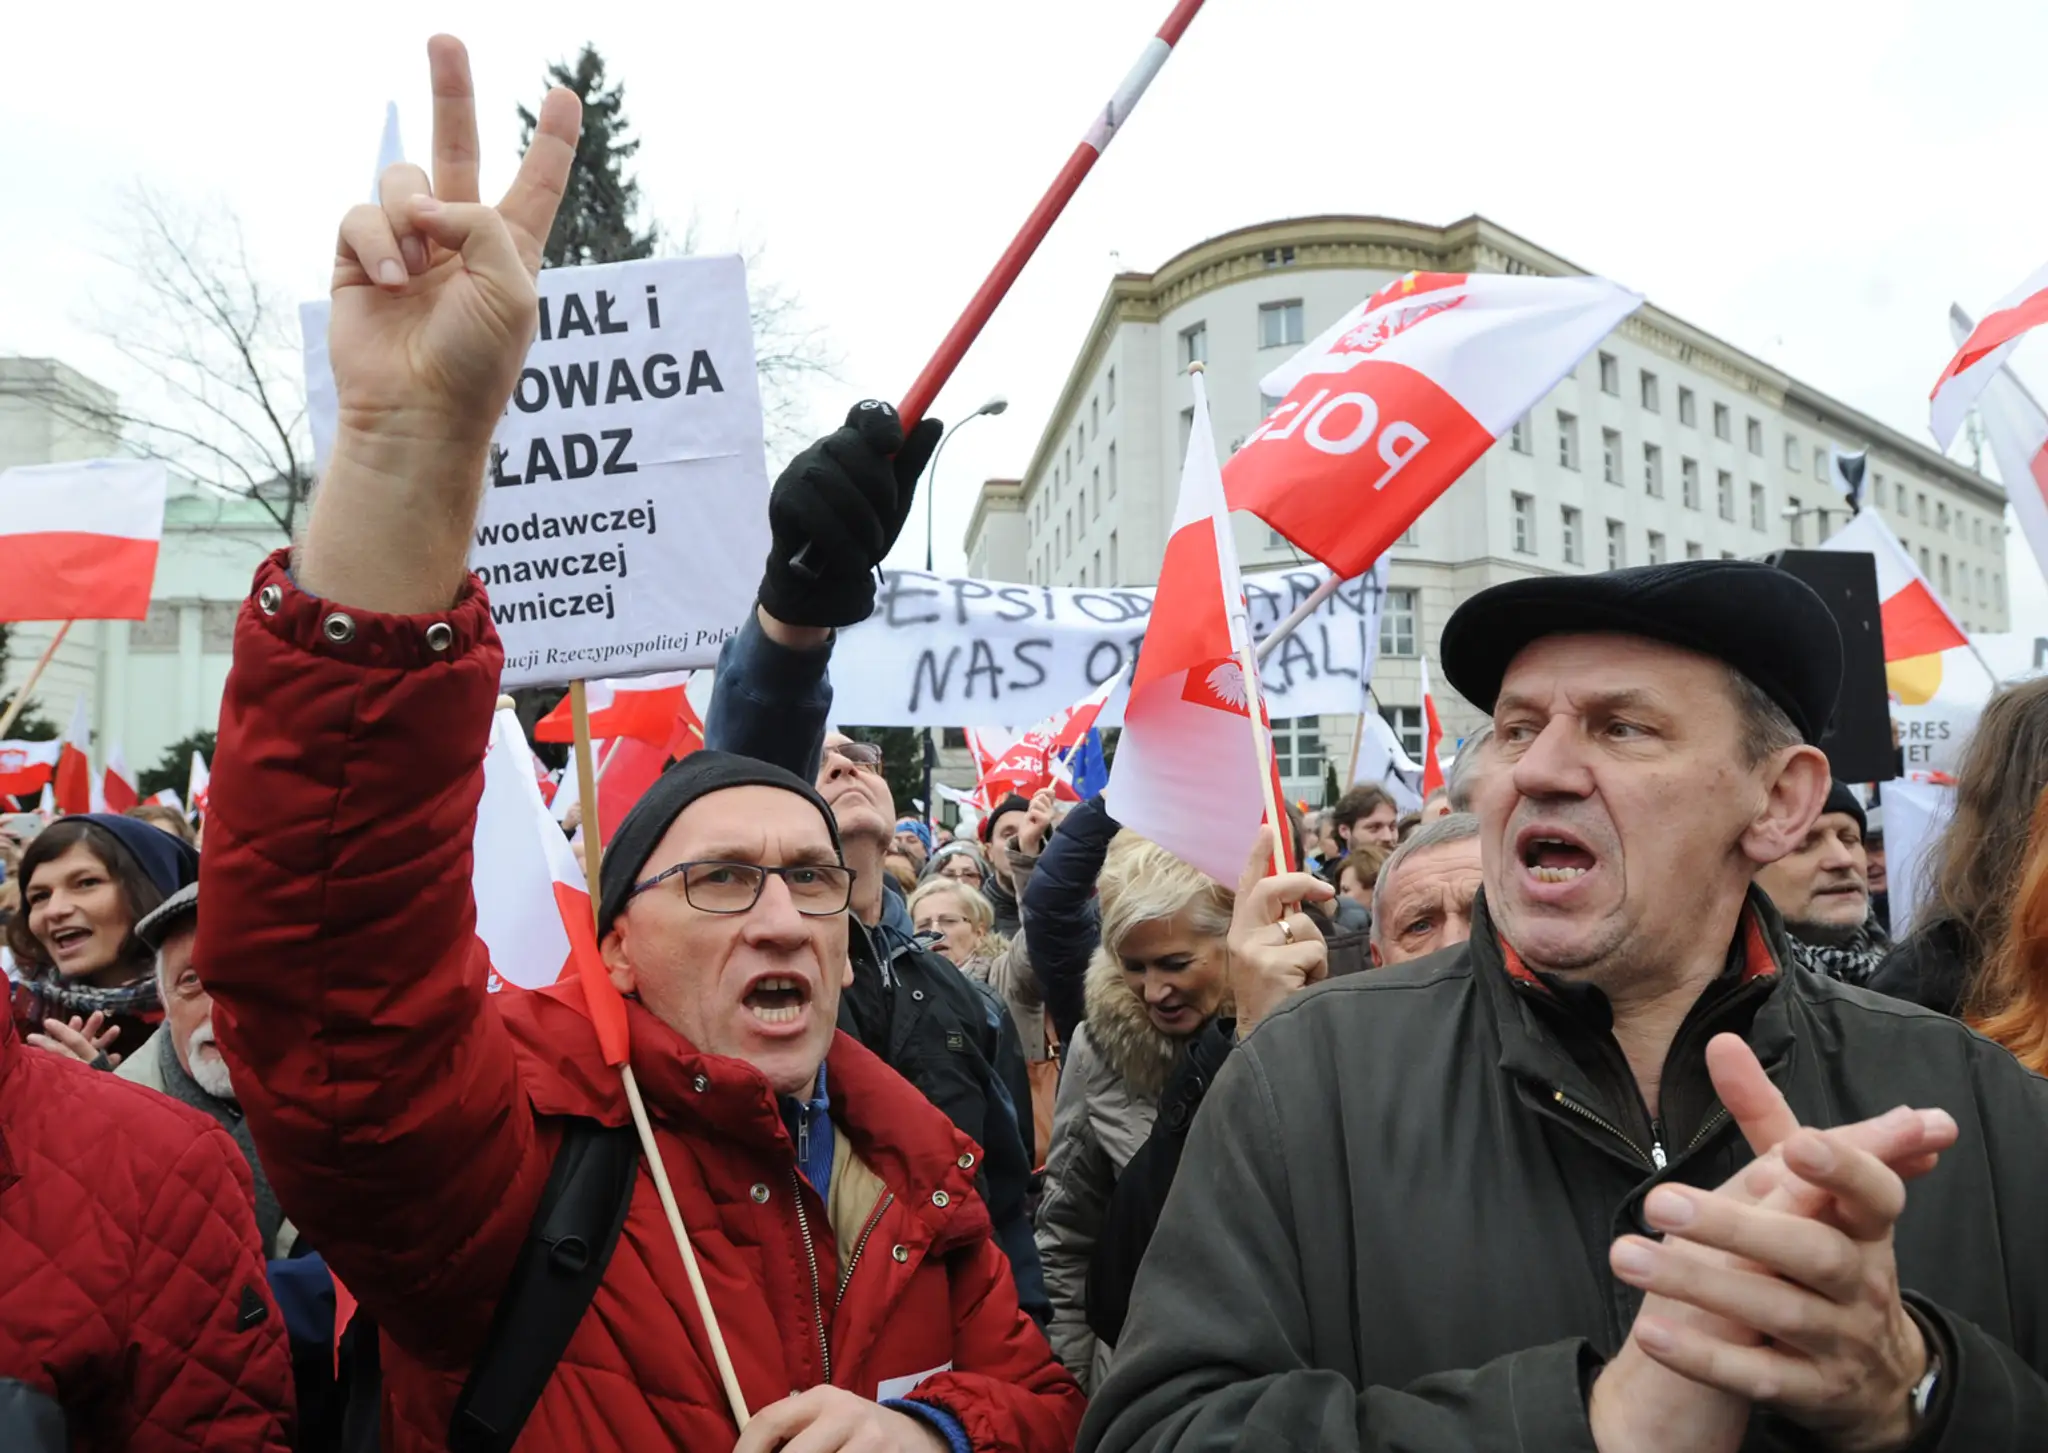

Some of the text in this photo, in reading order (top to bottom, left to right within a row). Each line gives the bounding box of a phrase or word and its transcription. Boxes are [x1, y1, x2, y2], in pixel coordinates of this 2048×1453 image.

[535, 284, 661, 341] IAŁ i
[505, 349, 724, 415] OWAGA
[490, 428, 638, 488] ŁADZ
[476, 499, 656, 547] wodawczej
[491, 584, 615, 625] wniczej
[1242, 565, 1383, 621] ARKA
[503, 650, 539, 671] ucji
[546, 632, 688, 664] Rzeczypospolitej
[909, 638, 1053, 713] NAS
